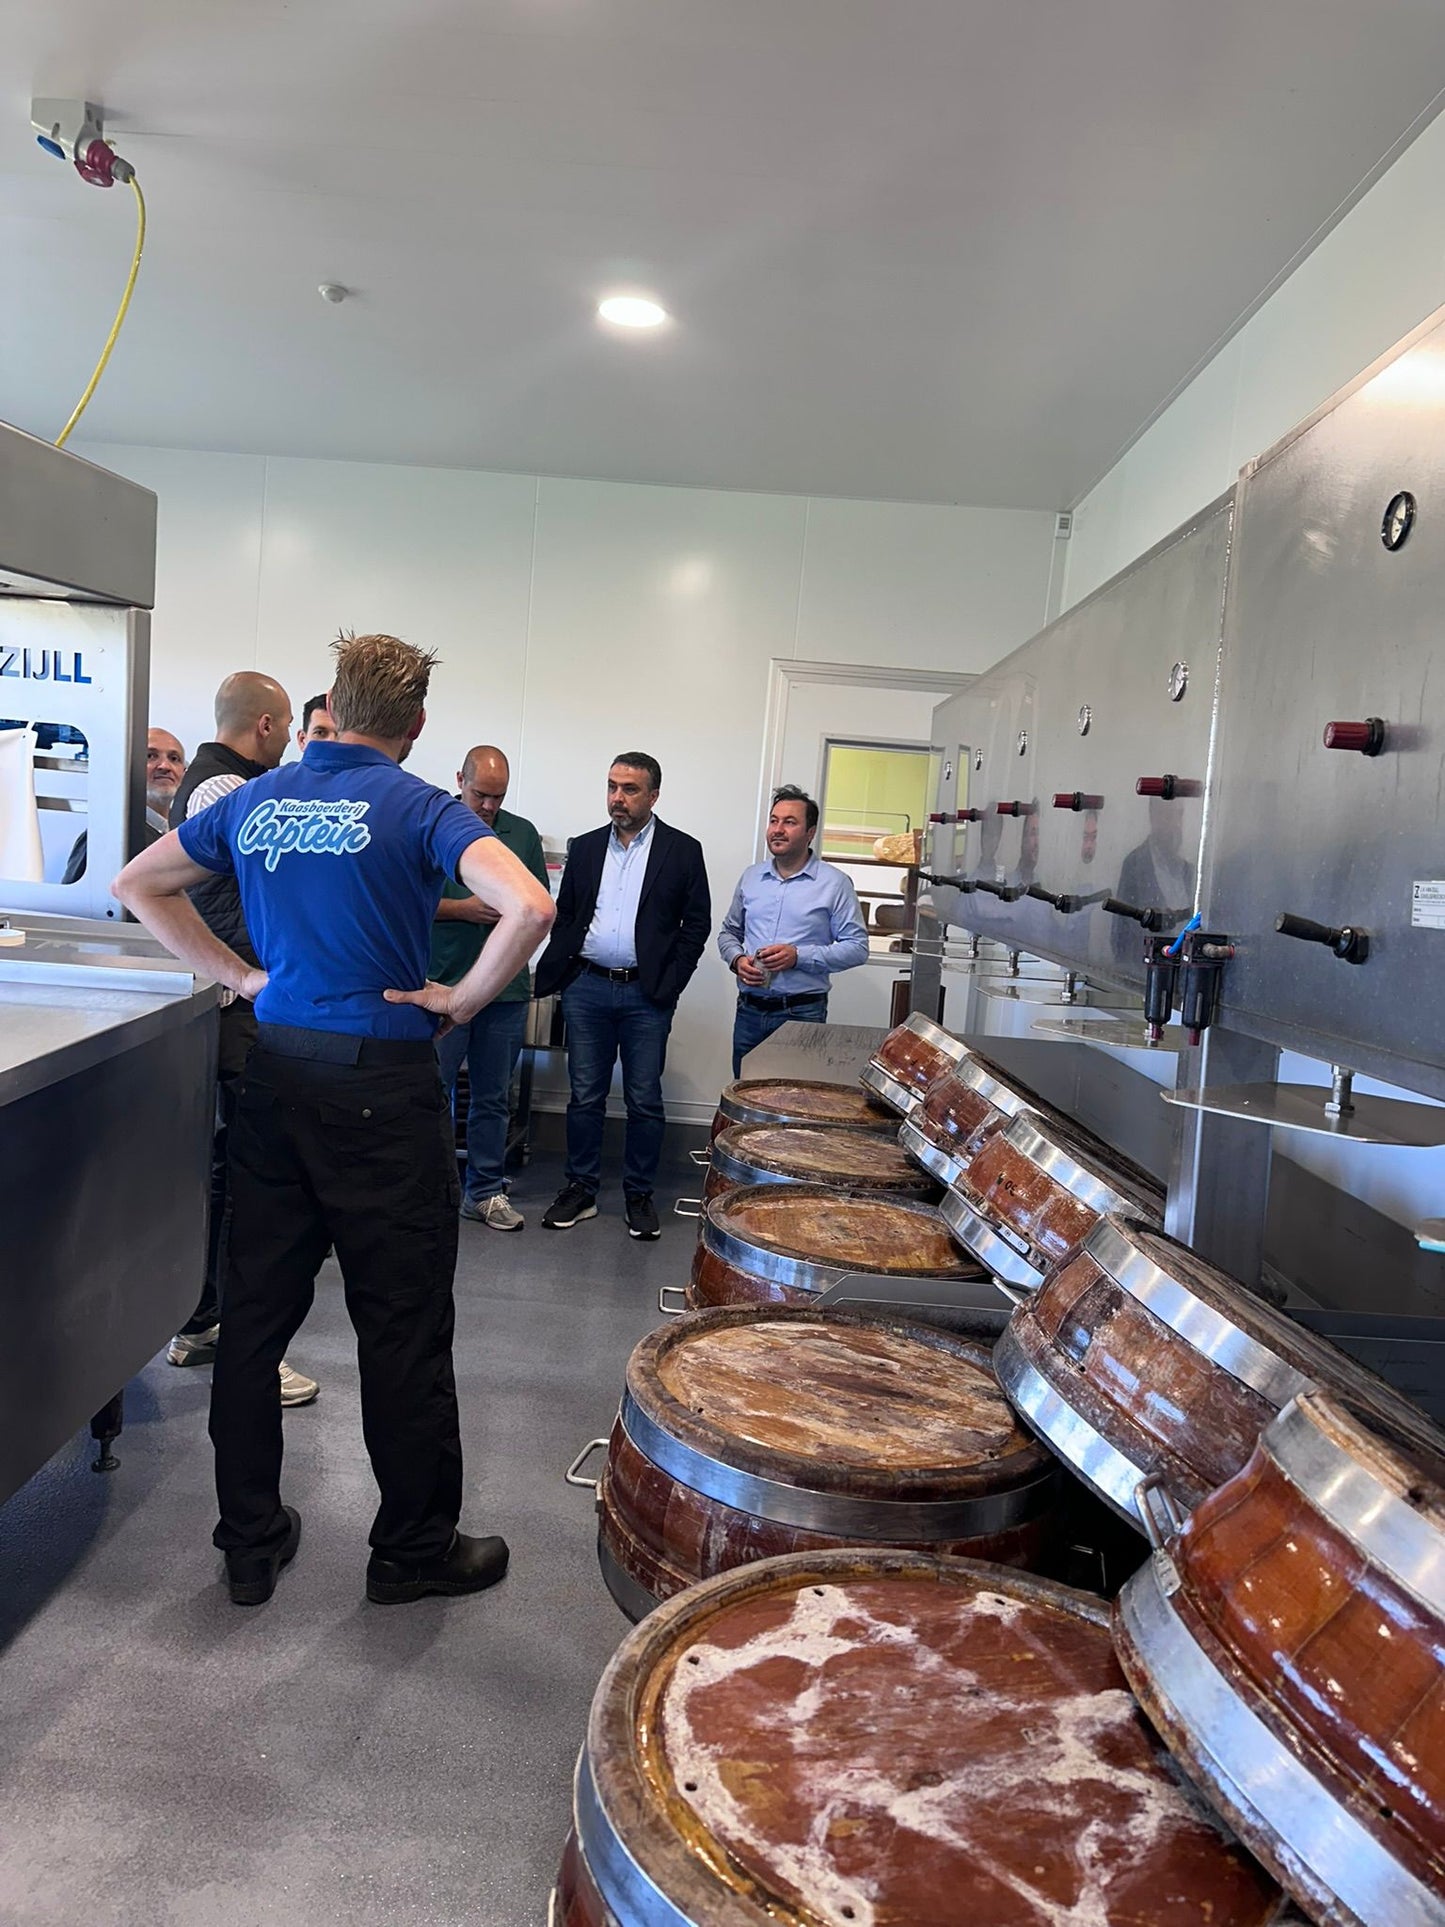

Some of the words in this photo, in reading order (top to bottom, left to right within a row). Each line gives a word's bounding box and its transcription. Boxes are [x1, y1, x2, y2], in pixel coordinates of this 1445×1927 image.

[0, 646, 92, 684] ZIJLL
[280, 801, 367, 817] Kaasboerderij
[239, 800, 370, 871] Captein
